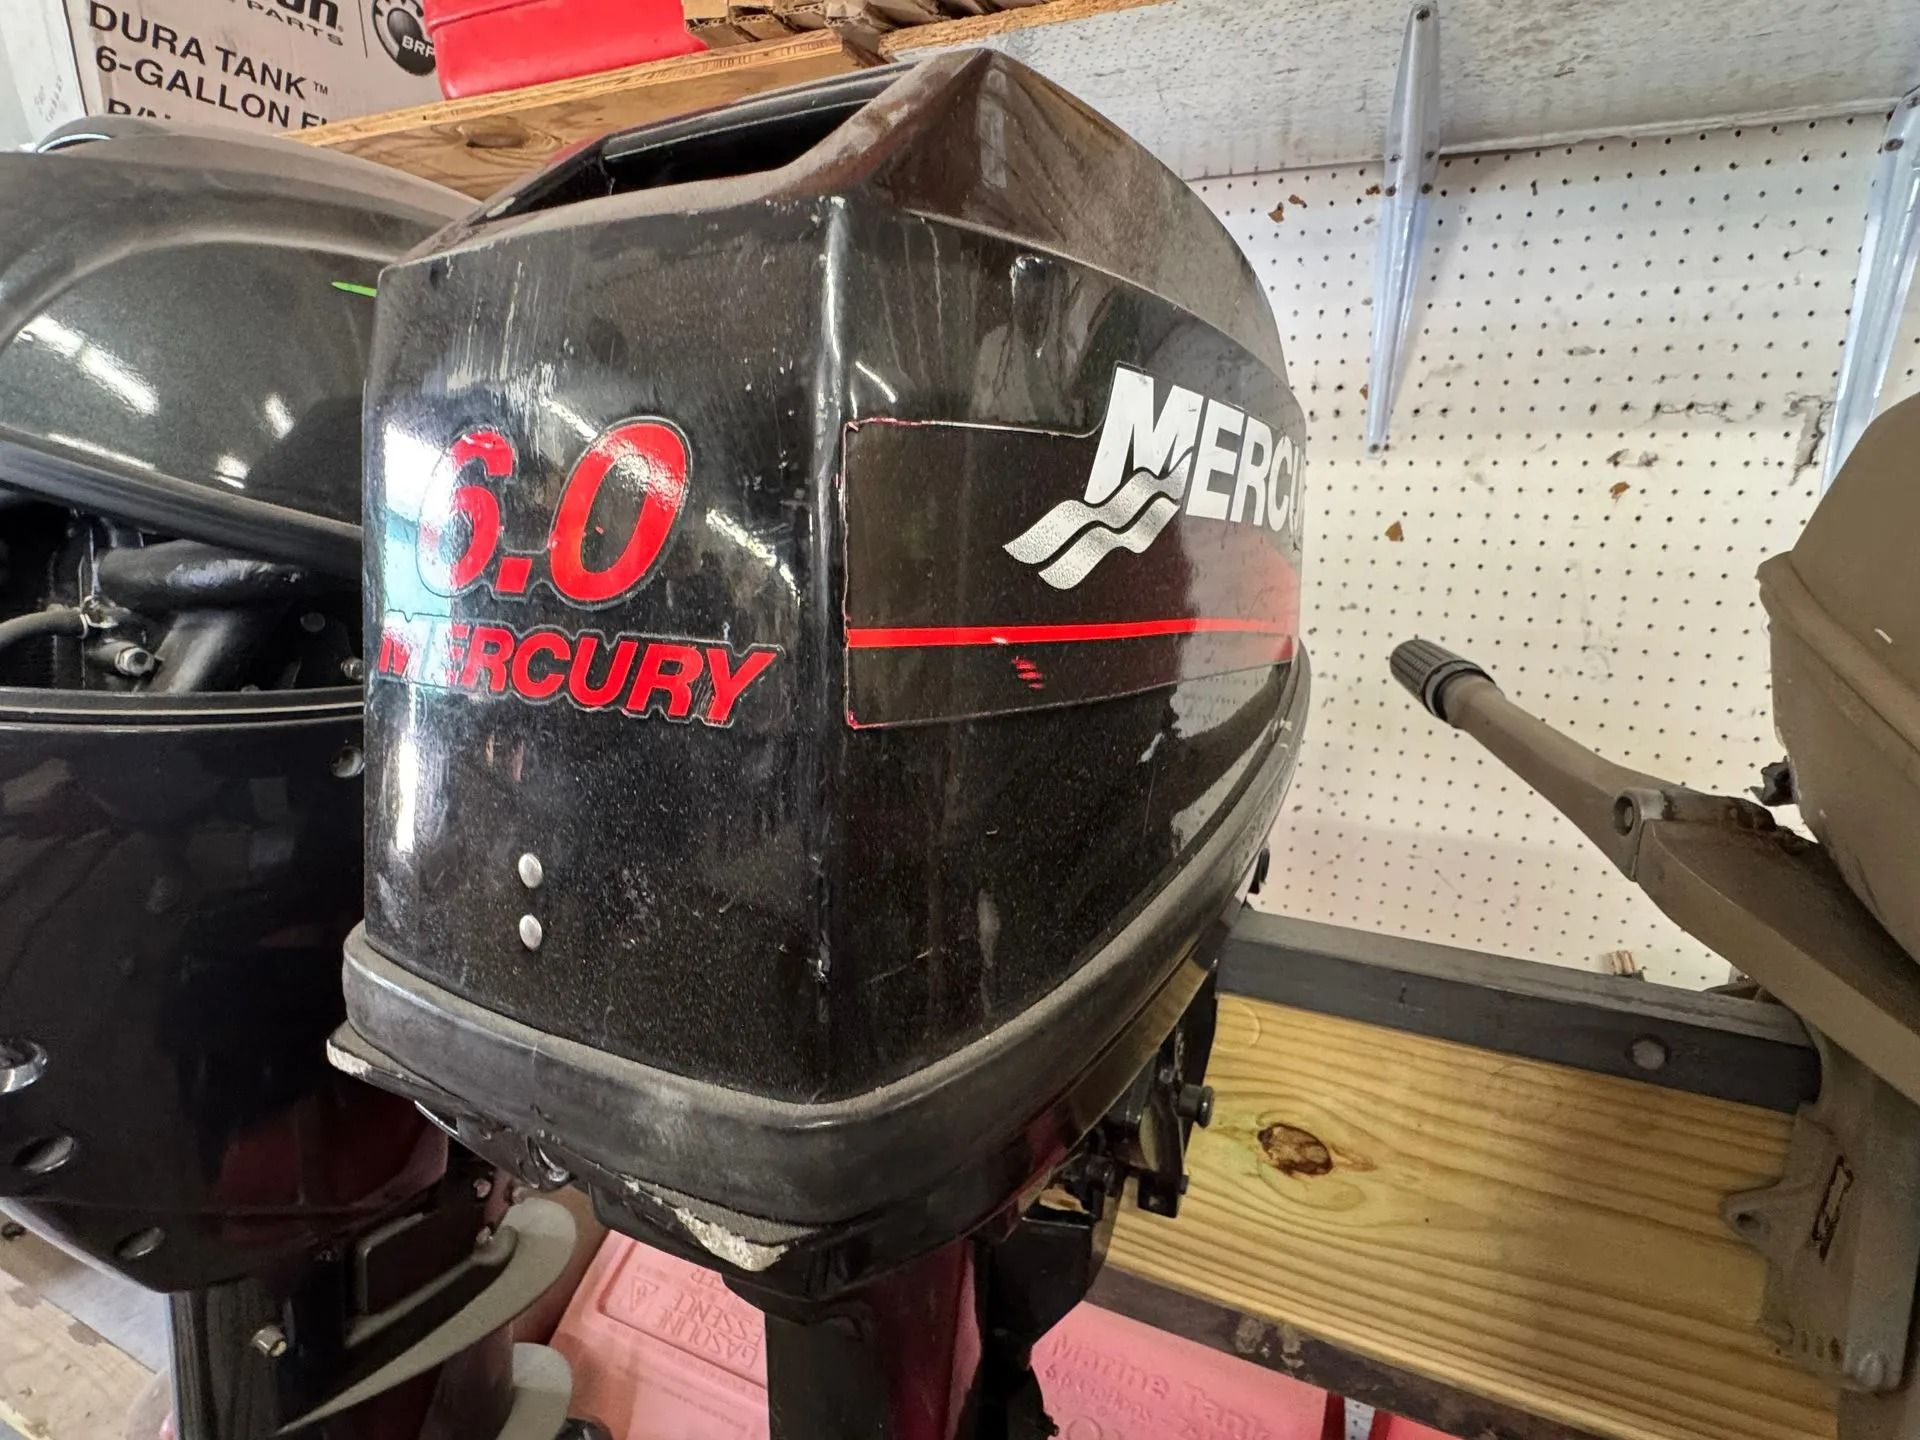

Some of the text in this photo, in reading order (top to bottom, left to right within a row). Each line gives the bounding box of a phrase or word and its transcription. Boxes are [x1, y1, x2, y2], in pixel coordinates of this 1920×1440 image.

[89, 0, 206, 66] DURA
[247, 0, 344, 46] PARTS
[96, 45, 290, 128] 6-GALLON
[417, 421, 689, 603] 6.0
